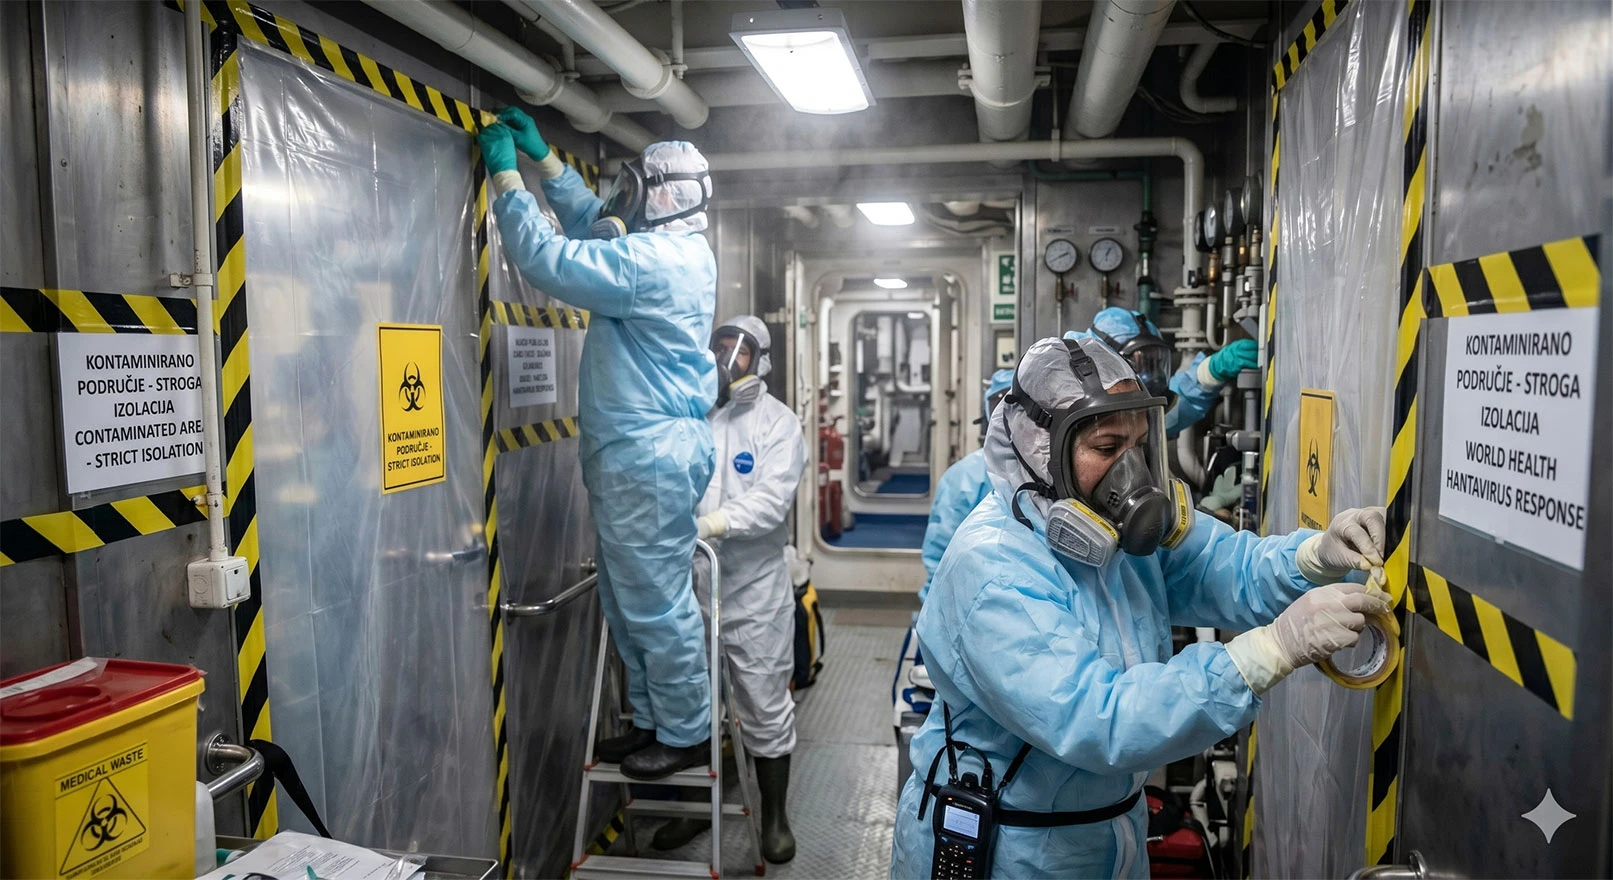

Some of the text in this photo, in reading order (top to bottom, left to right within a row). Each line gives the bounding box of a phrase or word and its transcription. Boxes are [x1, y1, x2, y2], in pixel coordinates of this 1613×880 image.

[1465, 331, 1572, 356] KONTAMINIRANO
[86, 353, 195, 370] KONTAMINIRANO
[77, 374, 146, 396] PODRUČJE
[155, 375, 203, 392] STROGA
[1456, 365, 1513, 393] PODRUČJE
[1524, 371, 1581, 399] STROGA
[113, 399, 175, 418] IZOLACIJA
[1480, 406, 1540, 435] IZOLACIJA
[74, 419, 204, 446] CONTAMINATED ARE
[387, 427, 440, 443] KONTAMINIRANO
[95, 449, 139, 469] STRICT
[141, 441, 204, 463] ISOLATION
[396, 440, 429, 456] PODRUČJE
[1465, 440, 1557, 481] WORLD HEALTH
[387, 453, 441, 472] STRICT ISOLATION
[1446, 469, 1585, 531] HANTAVIRUS RESPONSE
[60, 748, 144, 792] MEDICAL WASTE
